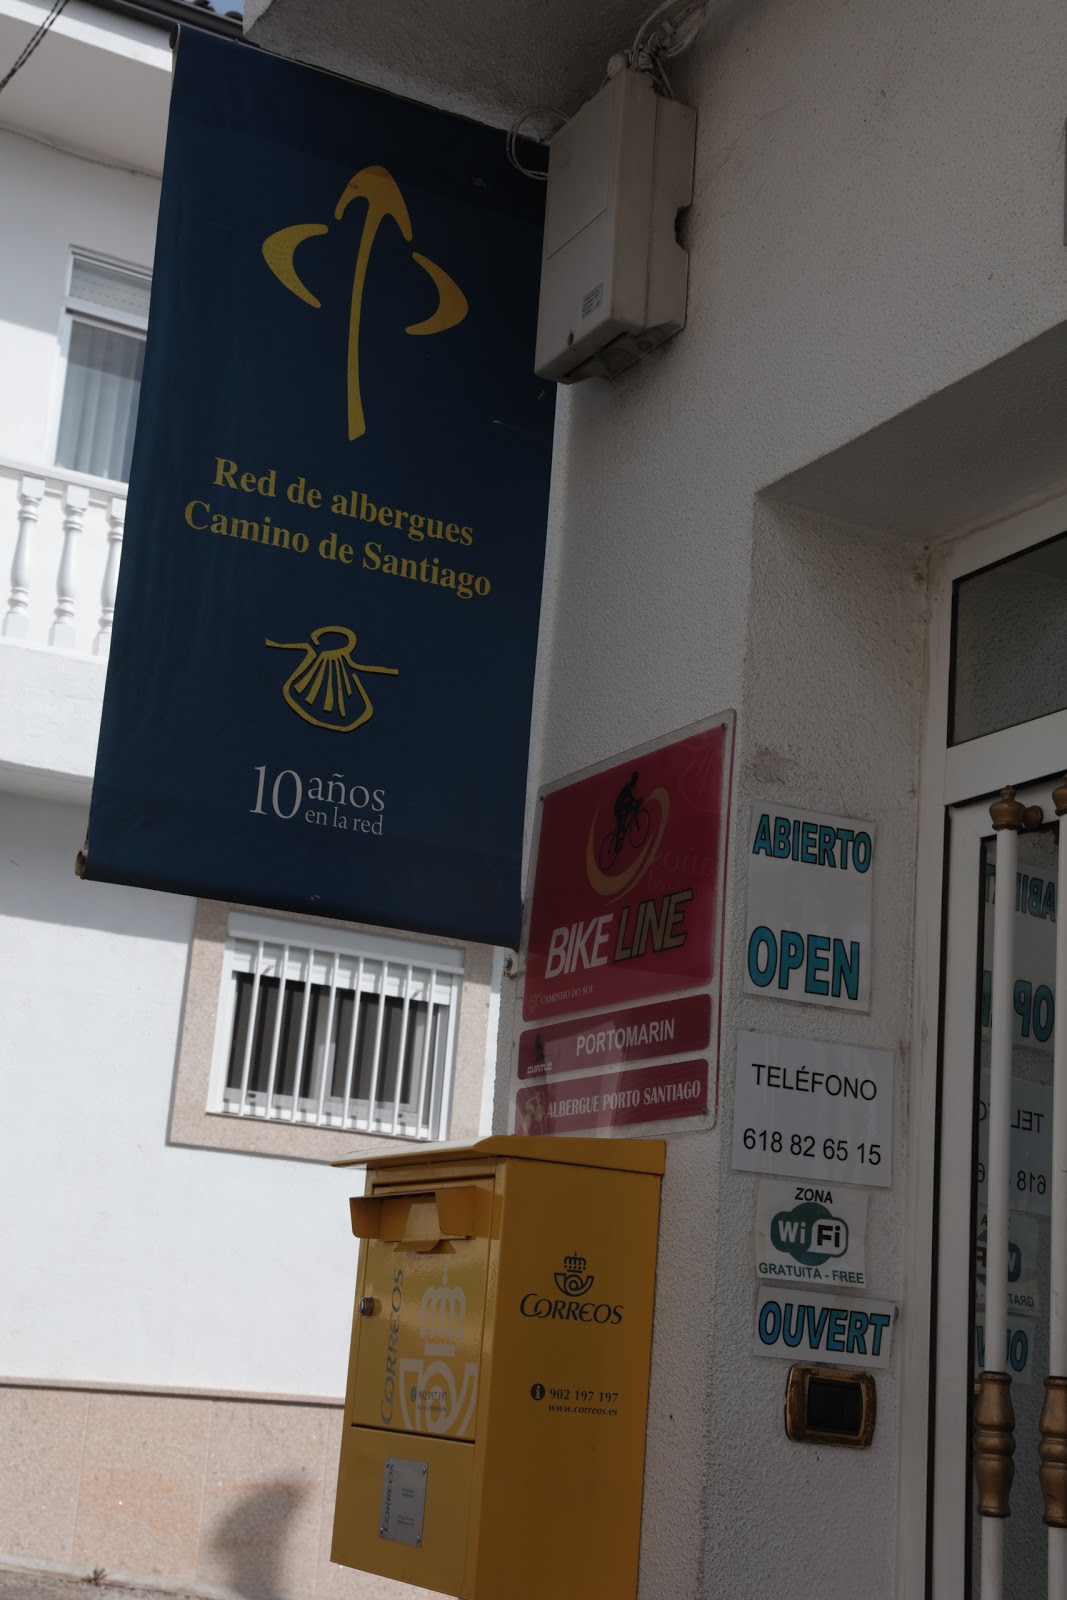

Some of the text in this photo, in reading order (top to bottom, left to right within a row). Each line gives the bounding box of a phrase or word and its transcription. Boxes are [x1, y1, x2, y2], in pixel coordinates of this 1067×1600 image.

[212, 457, 473, 546] Red de albergues
[184, 500, 491, 599] Camino de Santiago
[249, 764, 386, 820] 10 años
[305, 806, 384, 836] en la red
[752, 813, 872, 873] ABIERTO
[544, 888, 693, 980] BIKE LINE
[748, 925, 860, 1000] OPEN
[540, 988, 571, 1005] CAMINHO
[571, 987, 582, 998] DO
[576, 1018, 675, 1056] PORTOMARIN
[546, 1080, 701, 1119] ALBERGUE PORTO SANTIAGO
[751, 1063, 877, 1101] TELÉFONO
[743, 1128, 881, 1165] 618 82 65 15
[795, 1187, 833, 1204] ZONA
[759, 1262, 822, 1280] GRATUITA
[832, 1270, 865, 1284] FREE
[520, 1293, 624, 1325] CORREOS
[758, 1300, 891, 1356] OUVERT
[548, 1403, 618, 1416] www.correos.es
[549, 1388, 618, 1403] 902 197 197
